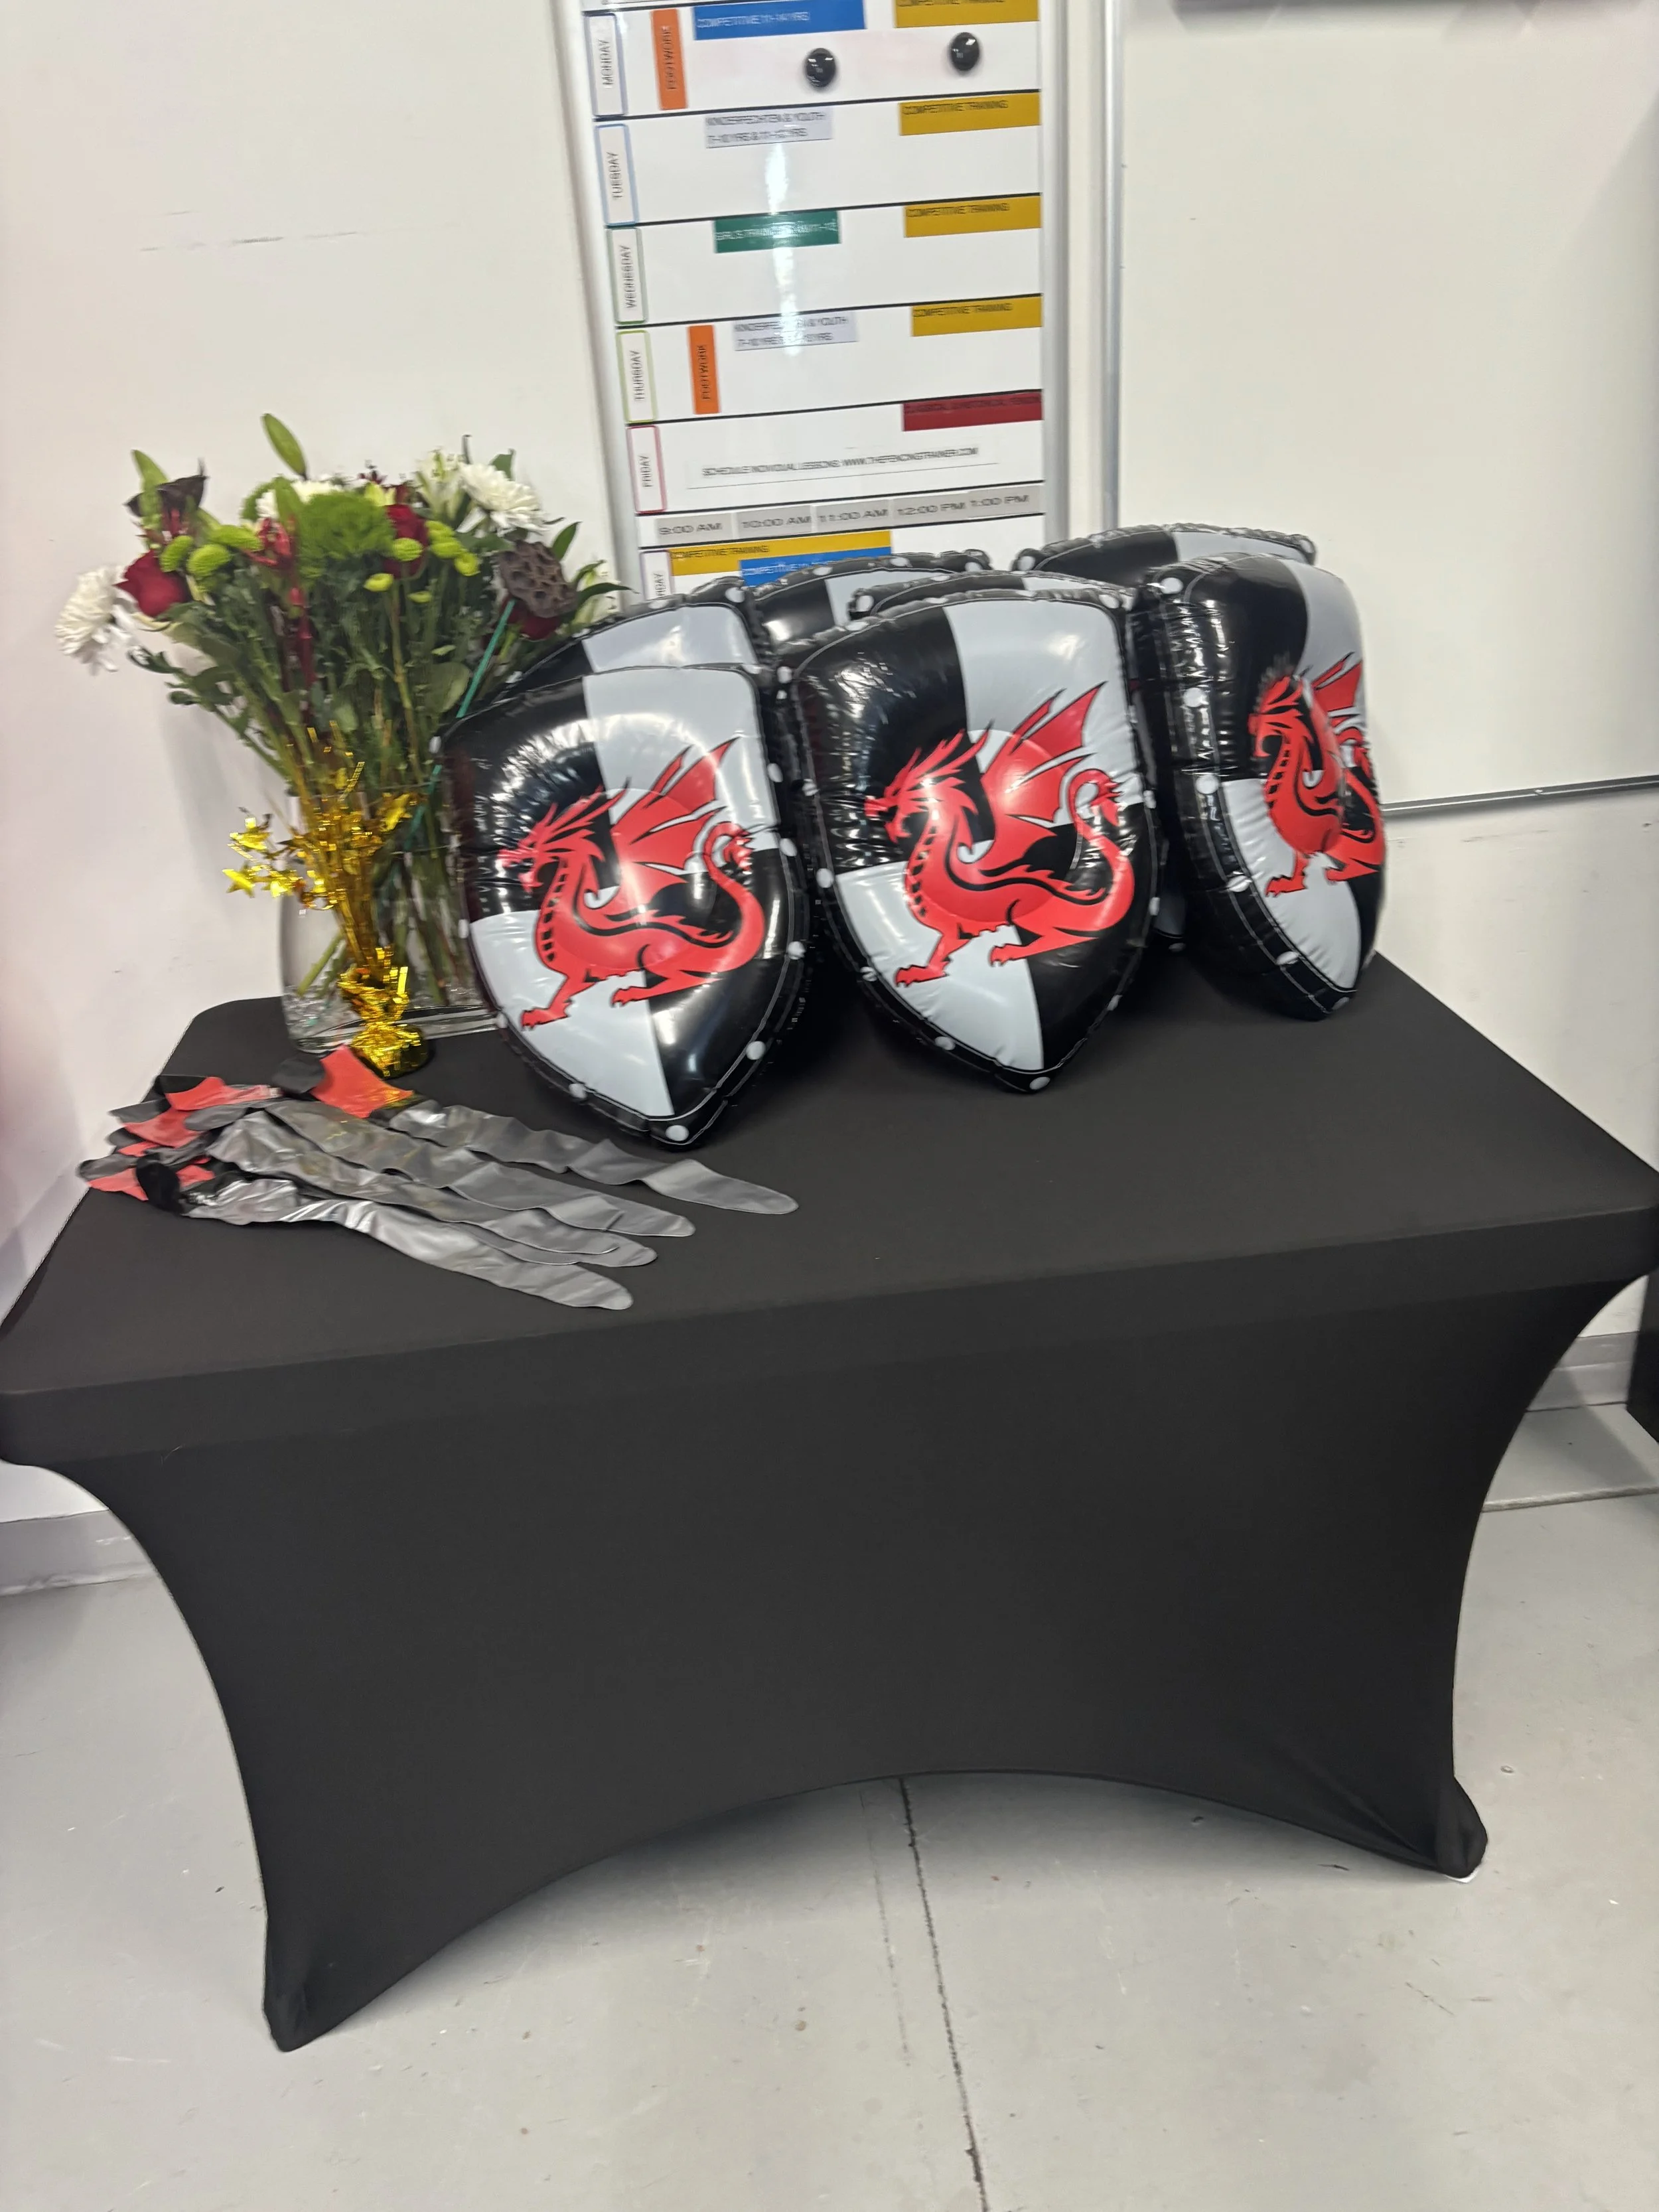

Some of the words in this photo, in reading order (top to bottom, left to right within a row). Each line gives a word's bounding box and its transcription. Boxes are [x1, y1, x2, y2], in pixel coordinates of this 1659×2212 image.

[599, 38, 614, 88] MONDAY
[607, 151, 623, 200] TUESDAY
[618, 245, 637, 309] WEDNESDAY
[629, 350, 645, 401] THURSDAY
[638, 455, 653, 487] FRIDAY
[897, 504, 938, 516] 12:00
[940, 502, 966, 511] PM
[1005, 494, 1029, 504] PM
[741, 518, 784, 529] 10:00
[786, 516, 812, 526] AM
[863, 508, 889, 518] AM
[697, 522, 723, 532] AM
